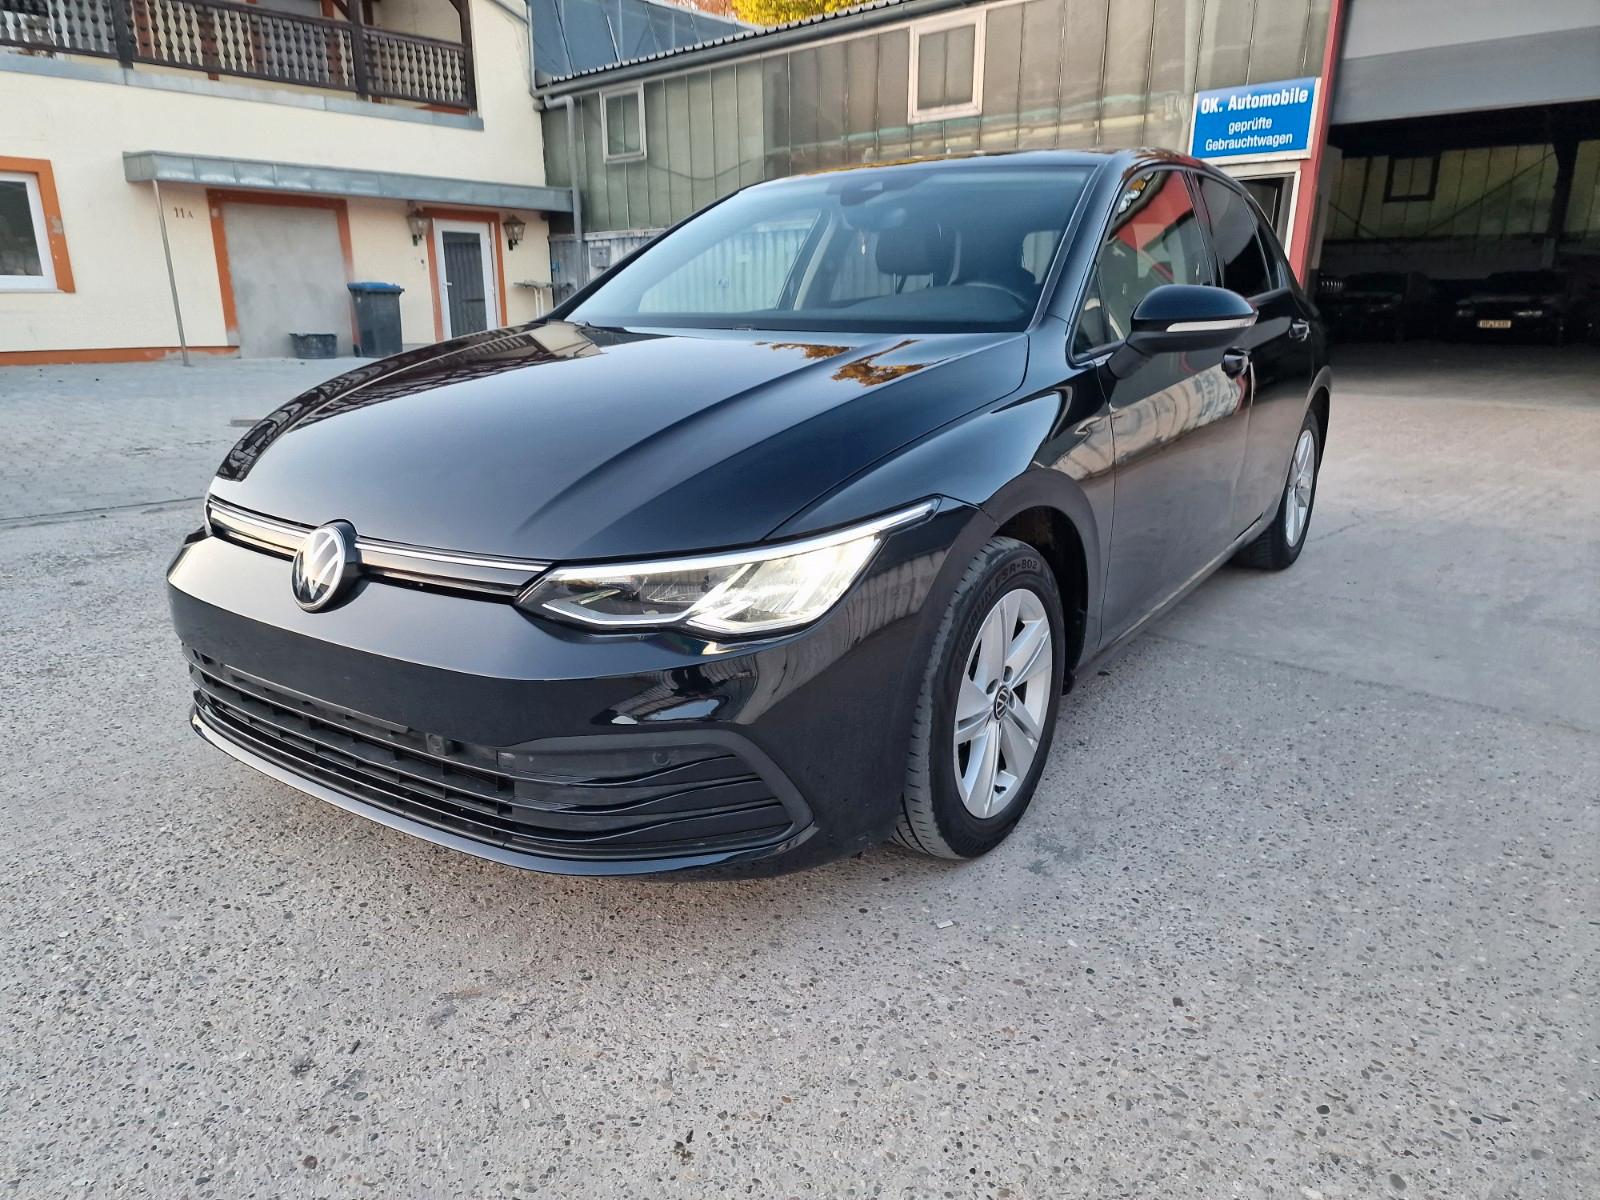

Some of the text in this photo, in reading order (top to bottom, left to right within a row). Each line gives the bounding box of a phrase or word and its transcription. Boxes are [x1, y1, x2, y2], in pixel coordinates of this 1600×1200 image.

[1201, 87, 1309, 114] OK. Automobile
[1228, 117, 1273, 135] geprüfte
[1205, 133, 1293, 151] Gebrauchtwagen
